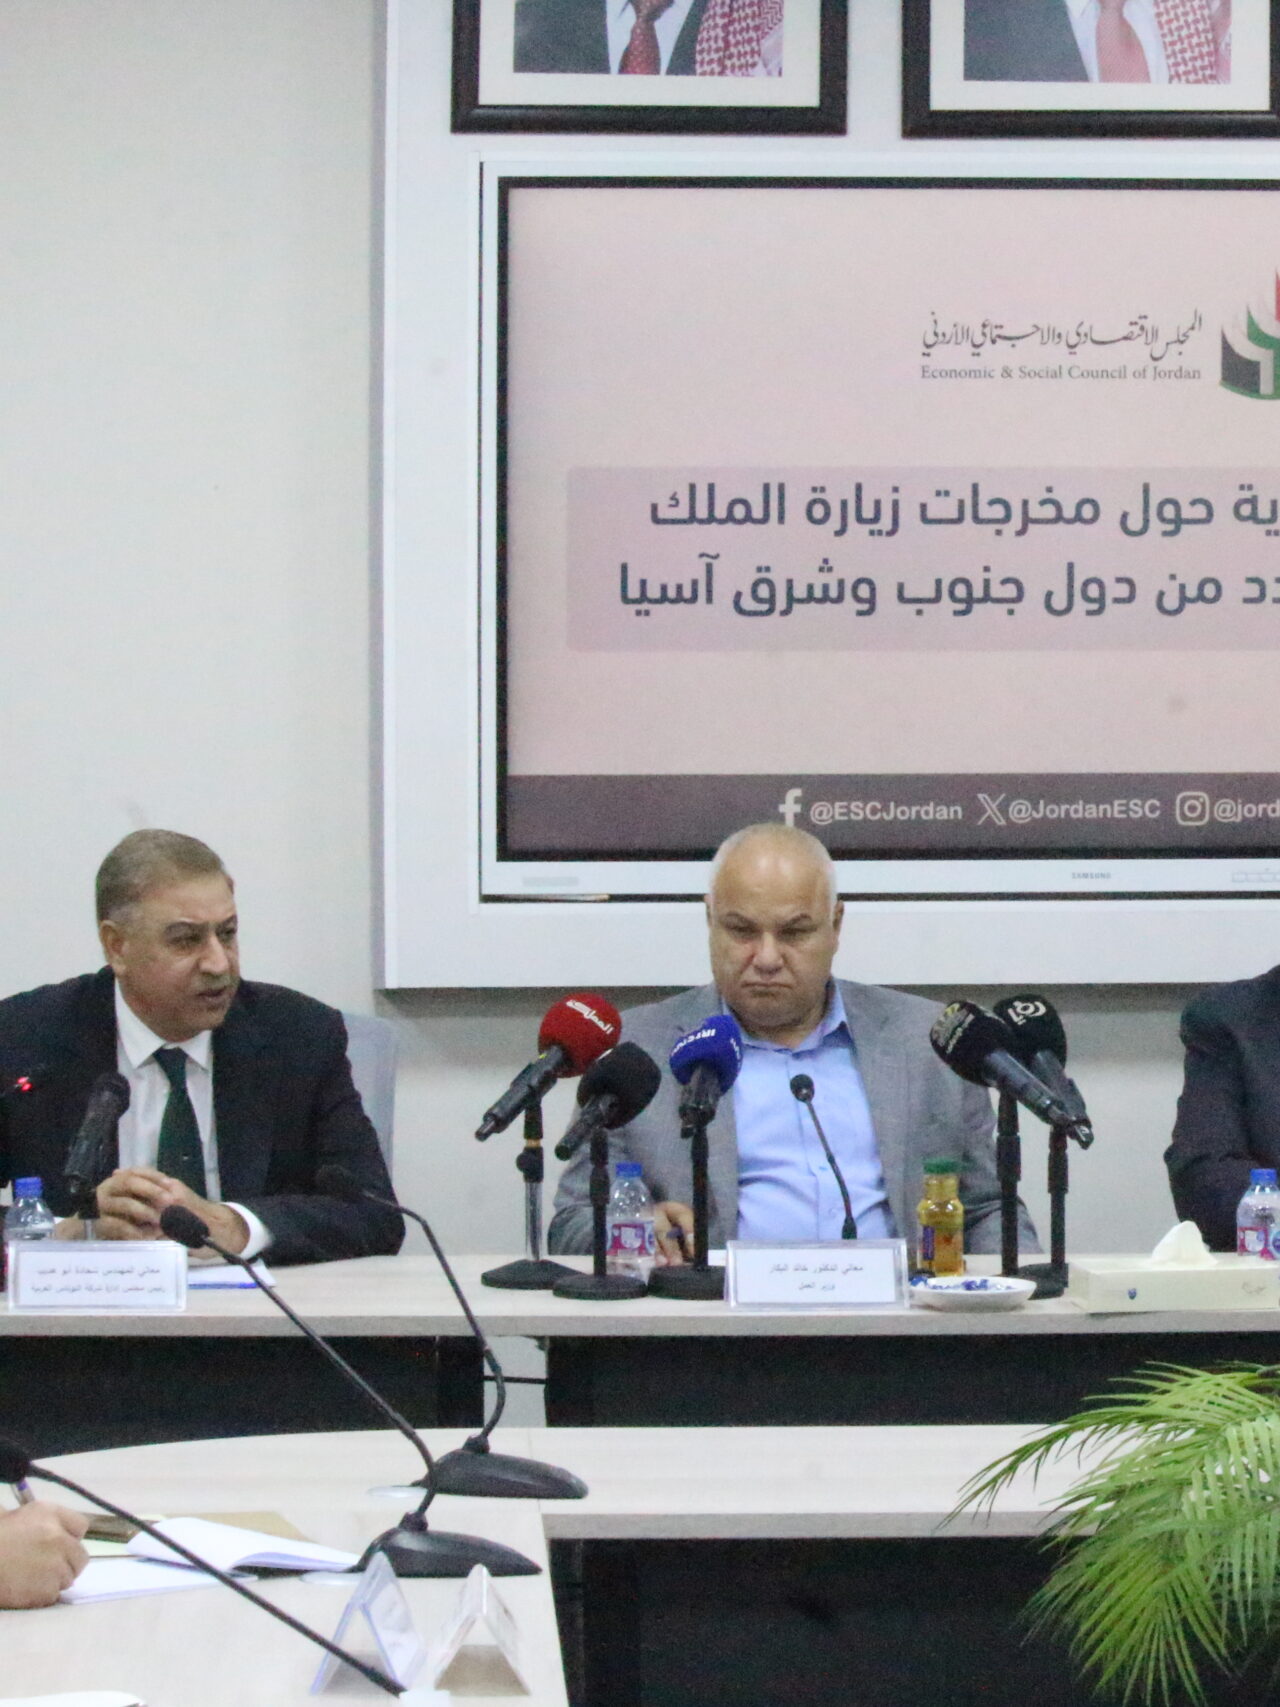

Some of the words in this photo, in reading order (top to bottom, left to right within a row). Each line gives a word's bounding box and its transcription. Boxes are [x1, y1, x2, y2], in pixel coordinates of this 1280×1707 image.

[970, 318, 1062, 357] والاجتماعي
[1065, 314, 1158, 355] الاقتصادي
[1151, 307, 1202, 362] المجلس
[920, 365, 995, 380] Economic
[1000, 365, 1013, 380] &
[1018, 364, 1062, 380] Social
[1067, 364, 1128, 380] Council
[1131, 365, 1147, 380] of
[1152, 365, 1202, 382] Jordan
[649, 481, 787, 526] الملك
[804, 482, 901, 538] زيارة
[918, 482, 1101, 538] مخرجات
[1118, 481, 1215, 538] حول
[619, 551, 721, 618] آسيا
[732, 557, 878, 618] وشرق
[895, 565, 1026, 617] جنوب
[1043, 561, 1137, 617] دول
[1154, 572, 1224, 617] من
[810, 800, 963, 824] @ESCJordan
[1008, 799, 1161, 824] @JordanESC
